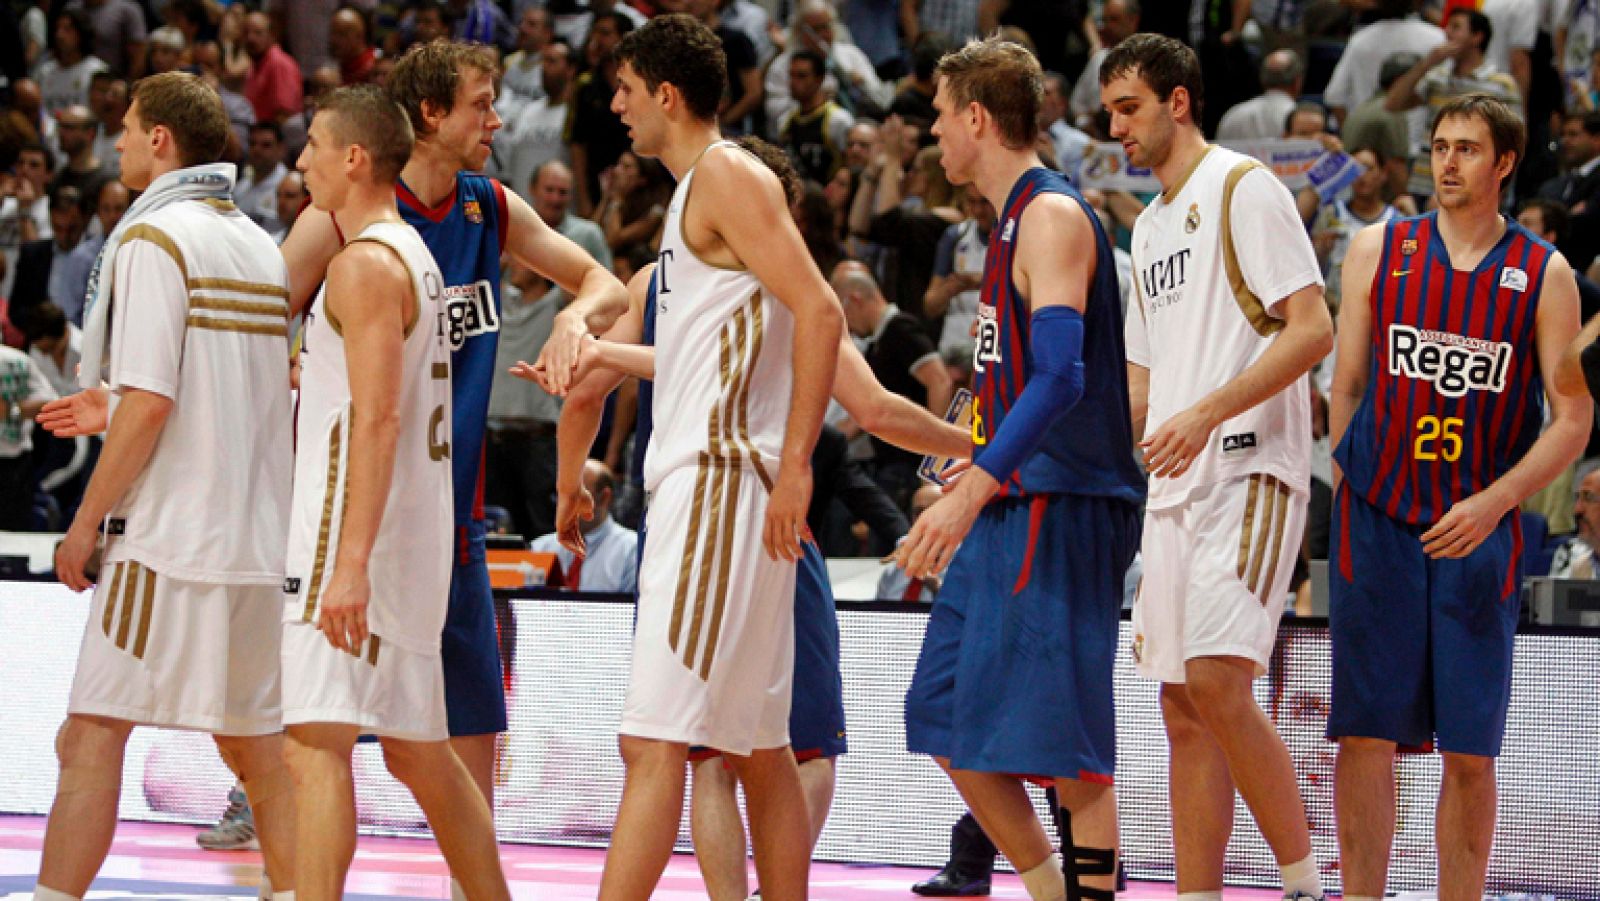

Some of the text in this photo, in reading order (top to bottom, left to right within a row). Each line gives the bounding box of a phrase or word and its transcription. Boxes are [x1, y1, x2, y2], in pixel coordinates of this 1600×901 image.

[447, 284, 496, 347] gal
[1391, 327, 1510, 393] Regal
[1414, 415, 1464, 462] 25
